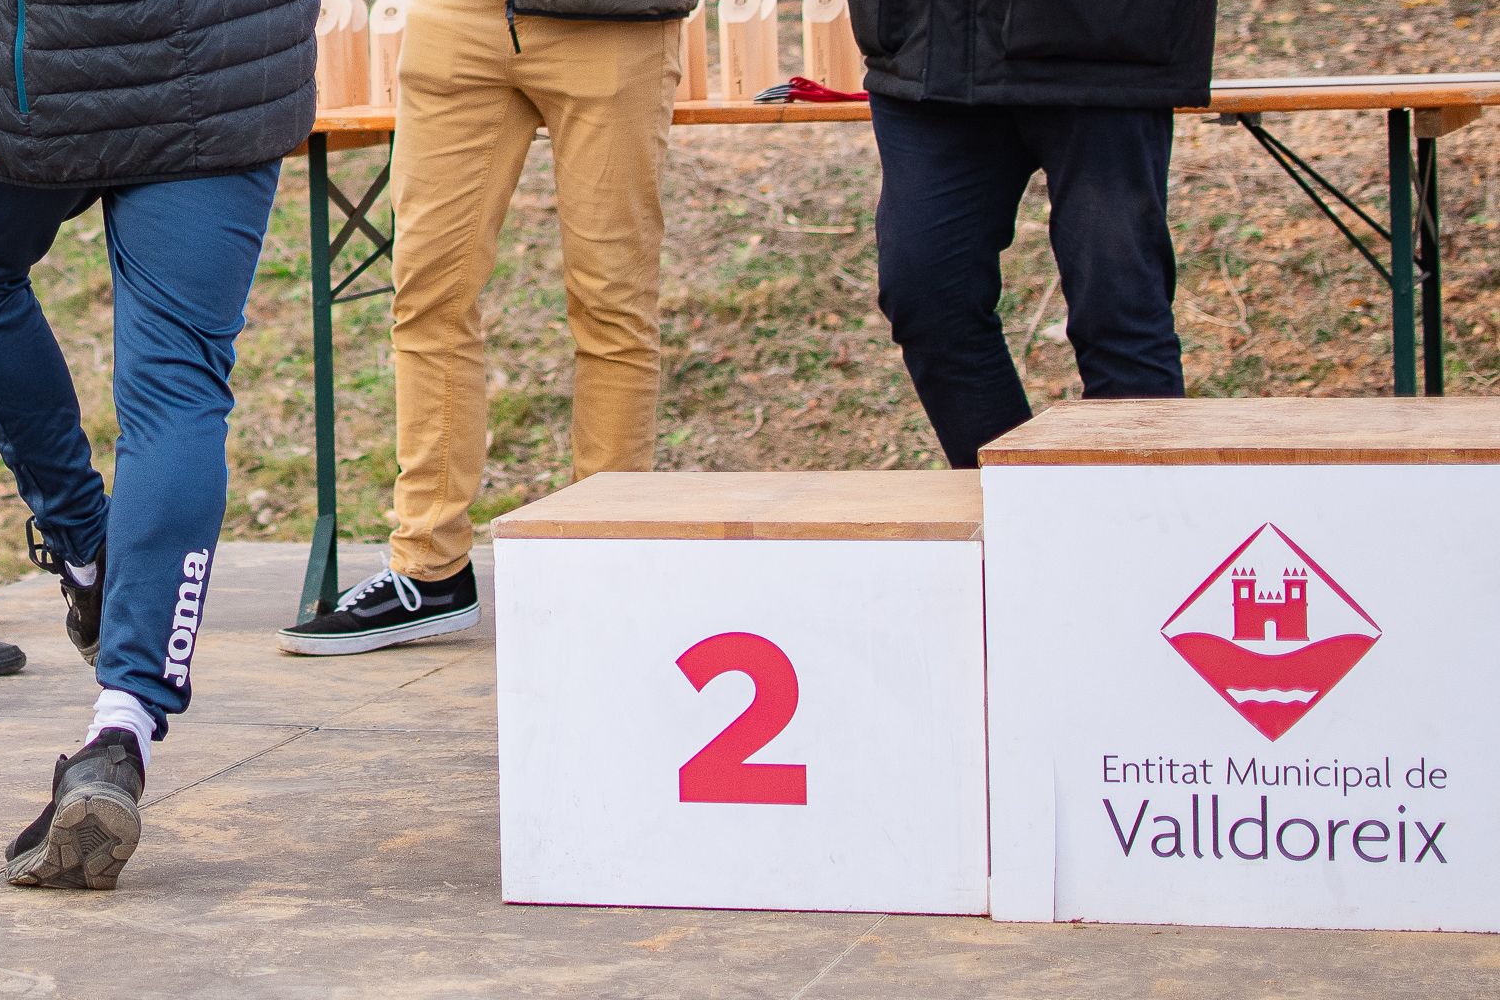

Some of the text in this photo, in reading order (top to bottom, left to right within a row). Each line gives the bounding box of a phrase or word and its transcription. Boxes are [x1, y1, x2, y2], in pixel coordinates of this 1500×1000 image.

[675, 632, 807, 805] 2
[1102, 755, 1447, 796] Entitat Municipal de
[1102, 794, 1448, 864] Valldoreix
